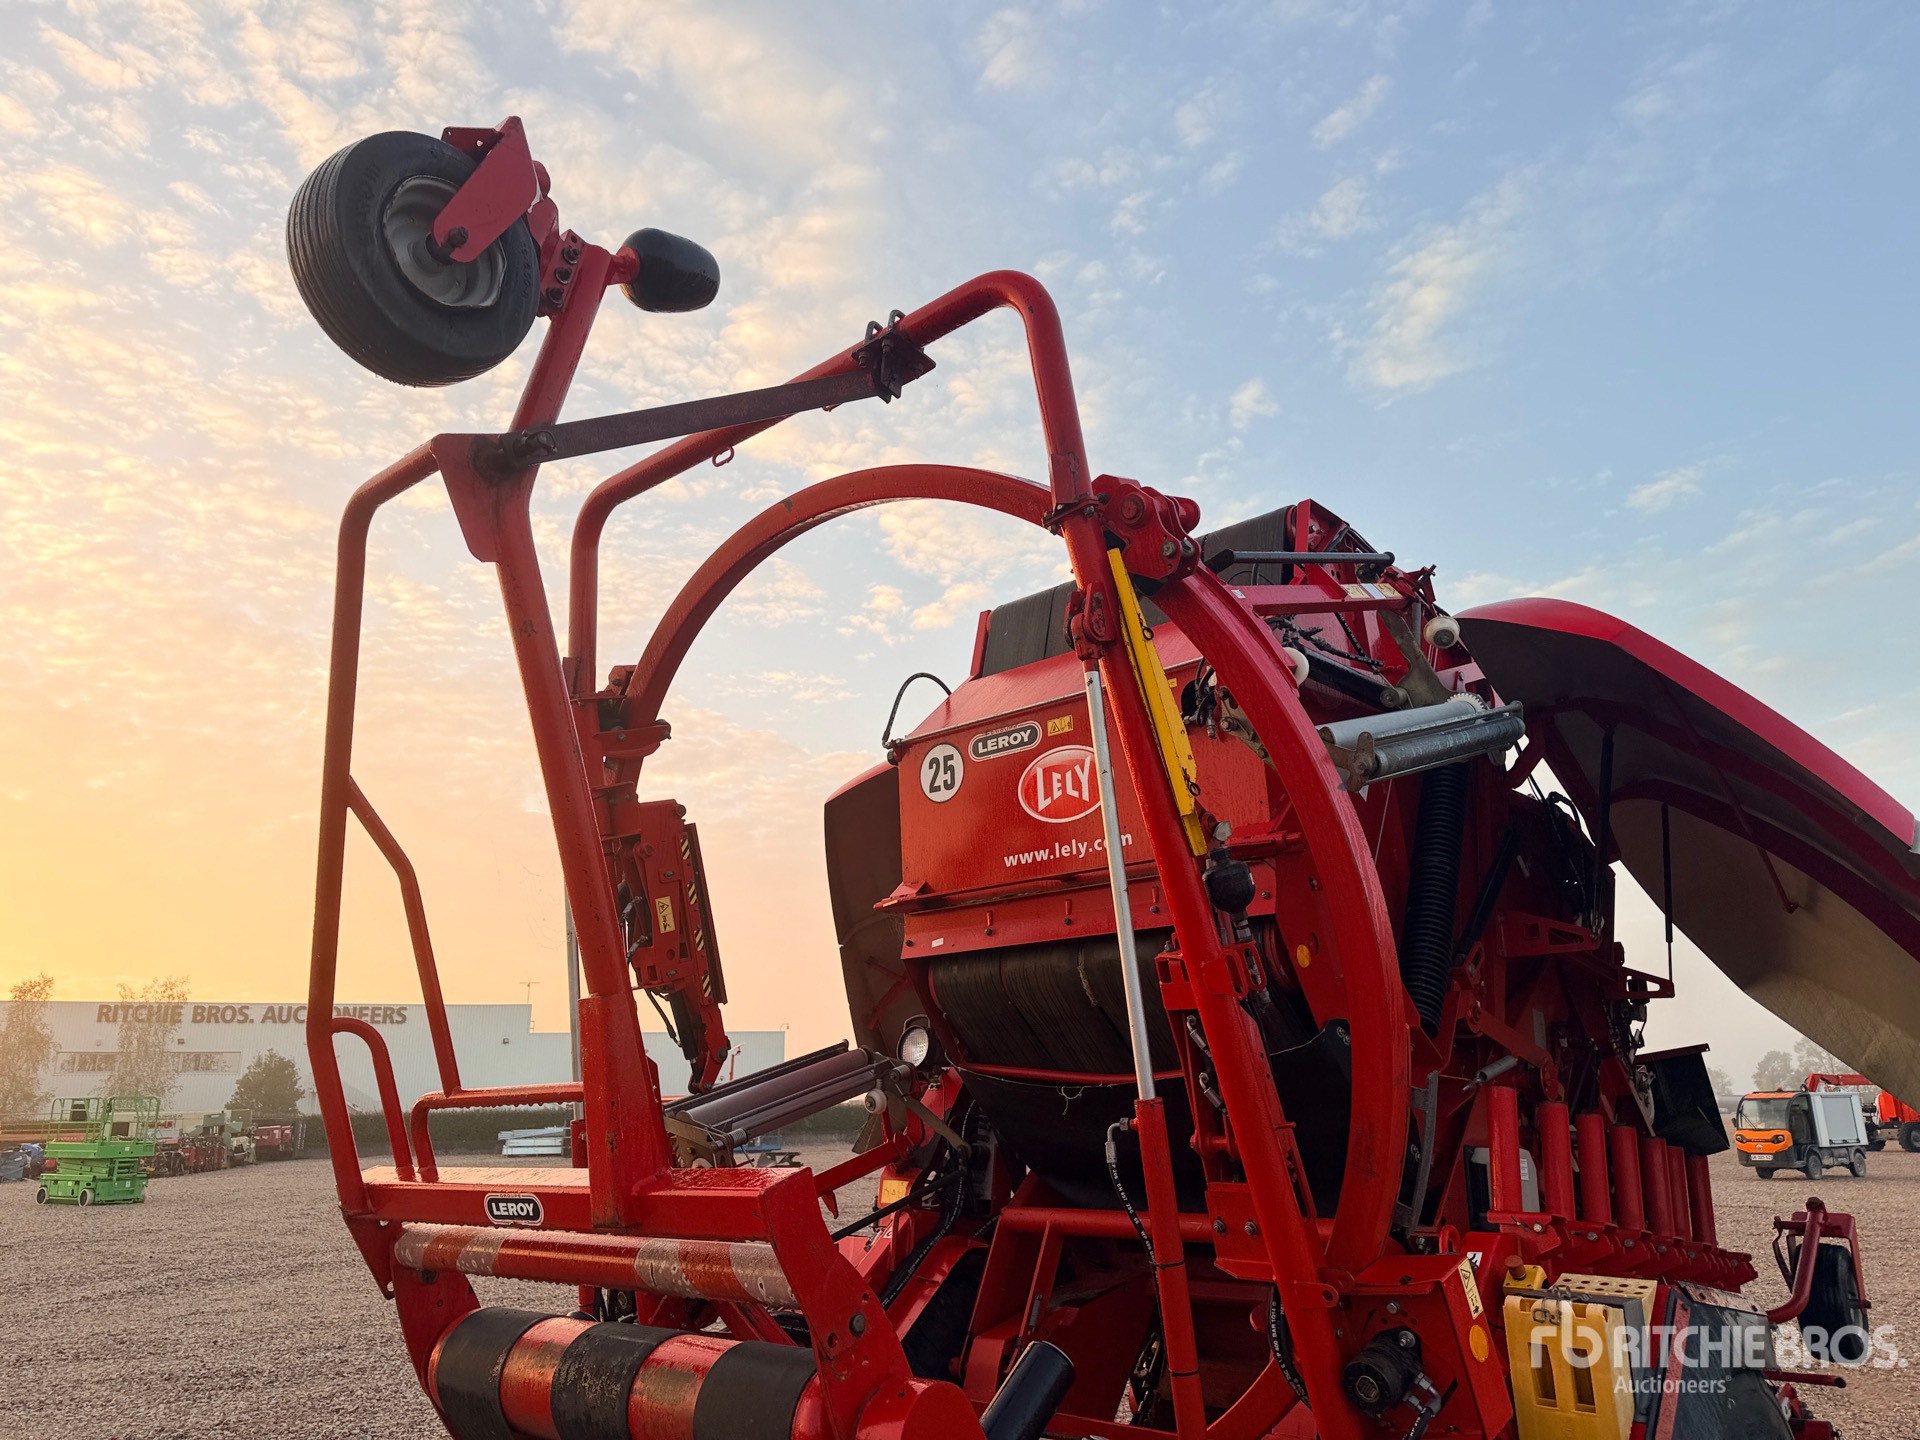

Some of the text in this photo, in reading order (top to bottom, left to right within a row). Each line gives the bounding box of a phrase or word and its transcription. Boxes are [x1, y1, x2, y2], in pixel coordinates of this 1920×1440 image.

[978, 729, 1031, 754] LEROY
[928, 754, 956, 793] 25
[1036, 755, 1091, 812] LELY
[97, 1004, 183, 1024] RITCHIE
[191, 1005, 254, 1024] BROS.
[491, 1202, 534, 1216] LEROY
